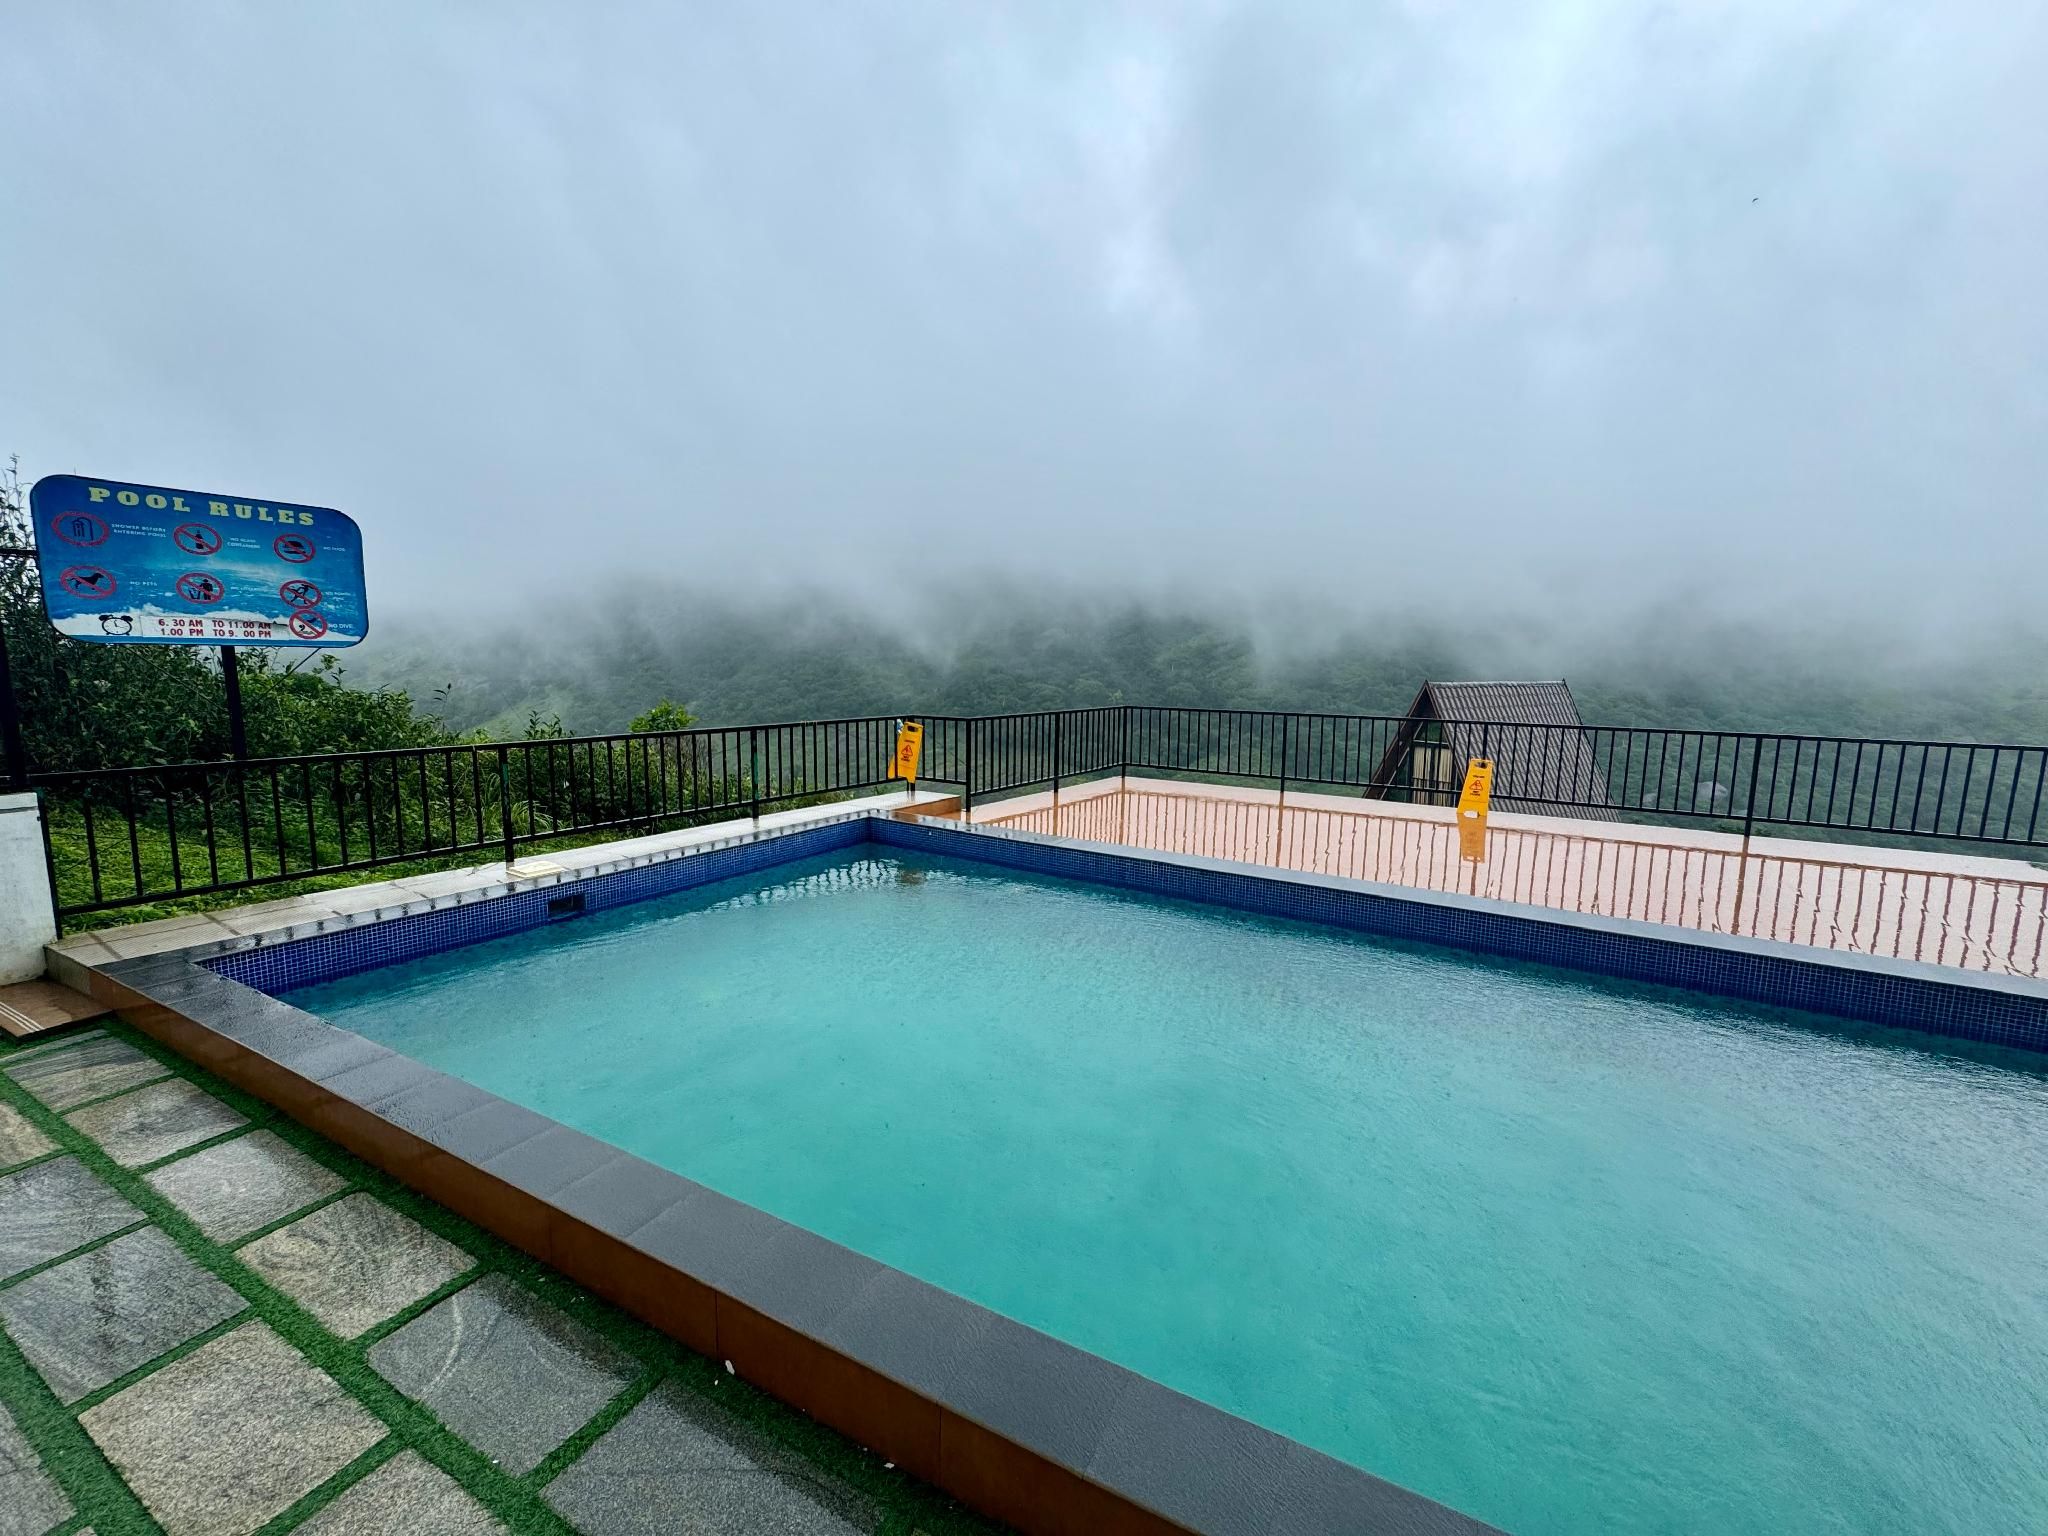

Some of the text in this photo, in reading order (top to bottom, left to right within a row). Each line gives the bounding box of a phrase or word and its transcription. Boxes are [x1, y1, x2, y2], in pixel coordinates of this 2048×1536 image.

[88, 486, 314, 526] POOL RULES
[188, 619, 203, 628] AM
[212, 619, 225, 628] TO
[228, 621, 255, 629] 11.00
[258, 621, 271, 630] AM
[160, 628, 183, 636] 1.00
[189, 628, 204, 637] PM
[213, 629, 226, 637] TO
[258, 630, 272, 638] PM
